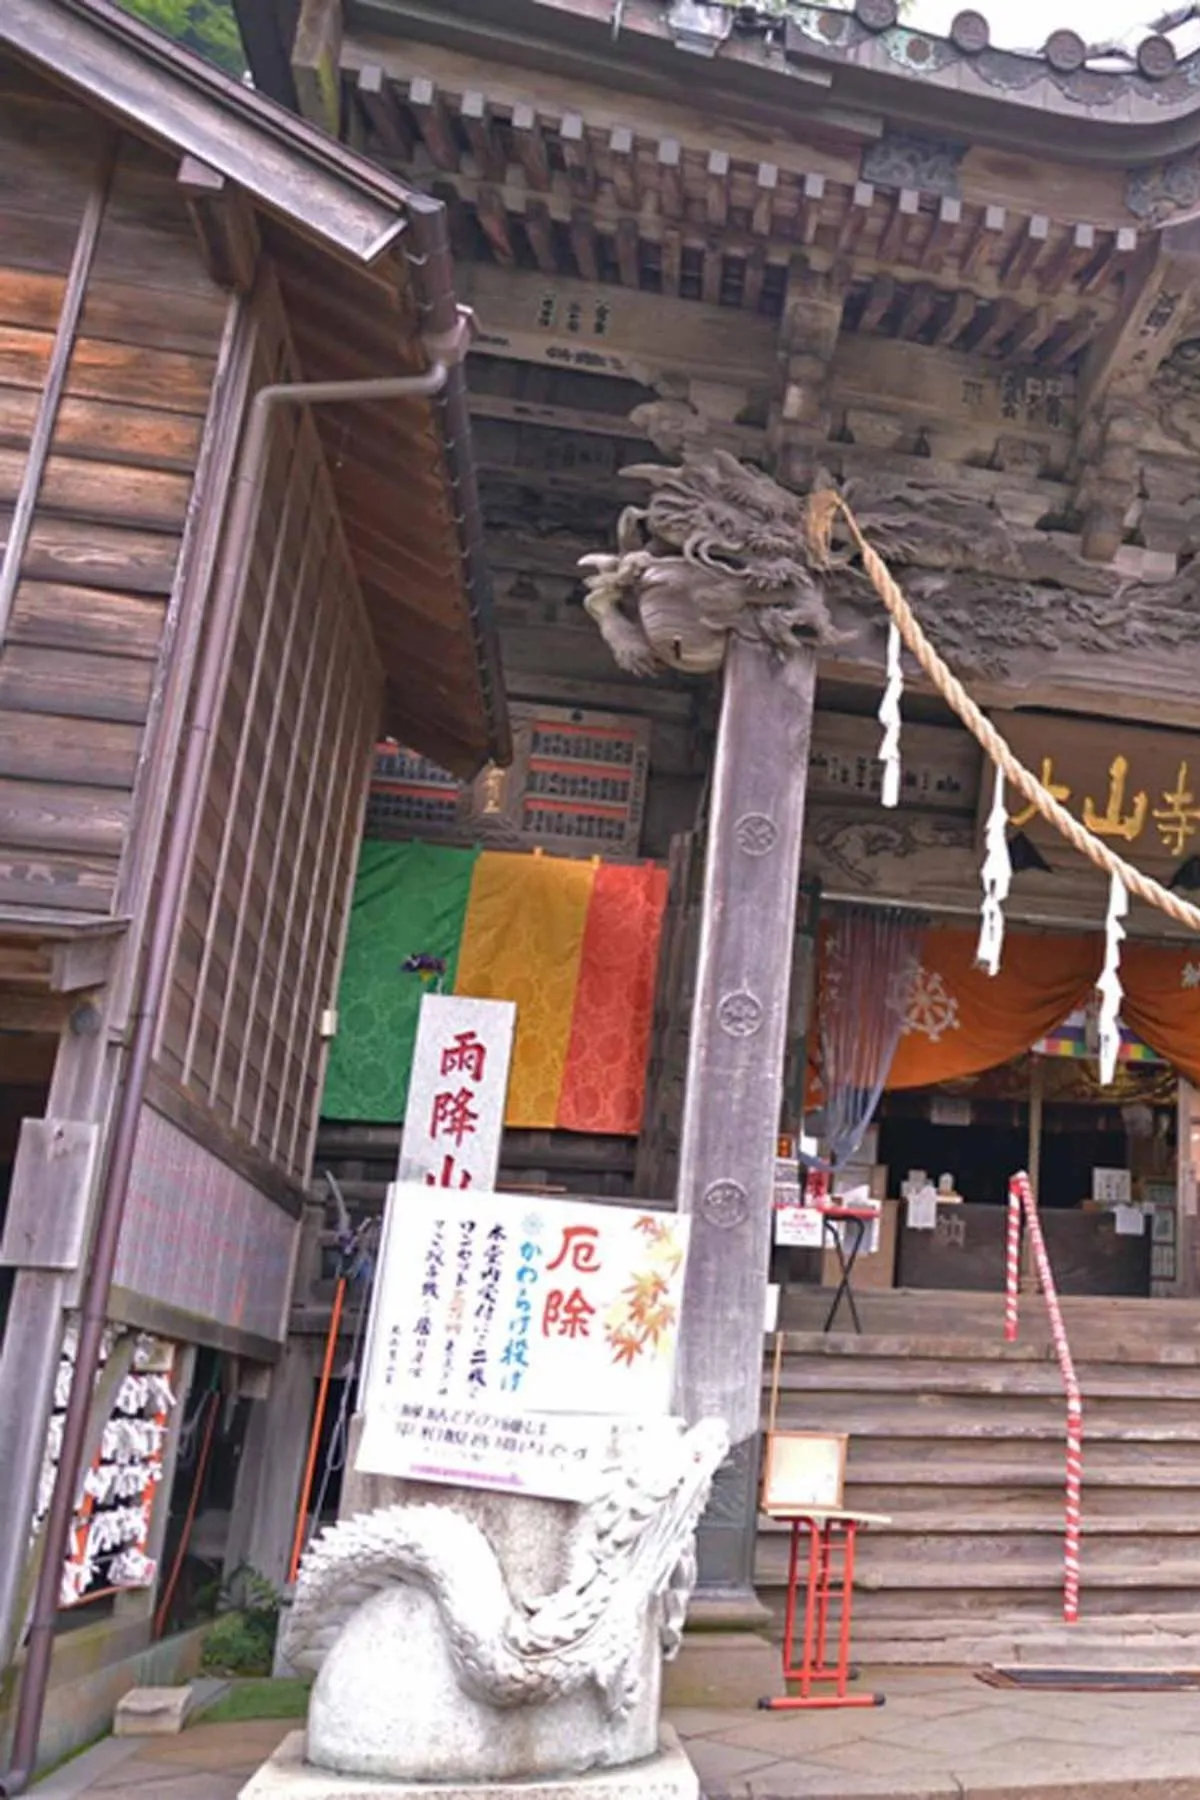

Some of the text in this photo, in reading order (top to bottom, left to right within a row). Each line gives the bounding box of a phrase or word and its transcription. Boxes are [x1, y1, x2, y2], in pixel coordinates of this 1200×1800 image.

[425, 1030, 488, 1190] 雨降山
[541, 1225, 602, 1339] 厄除
